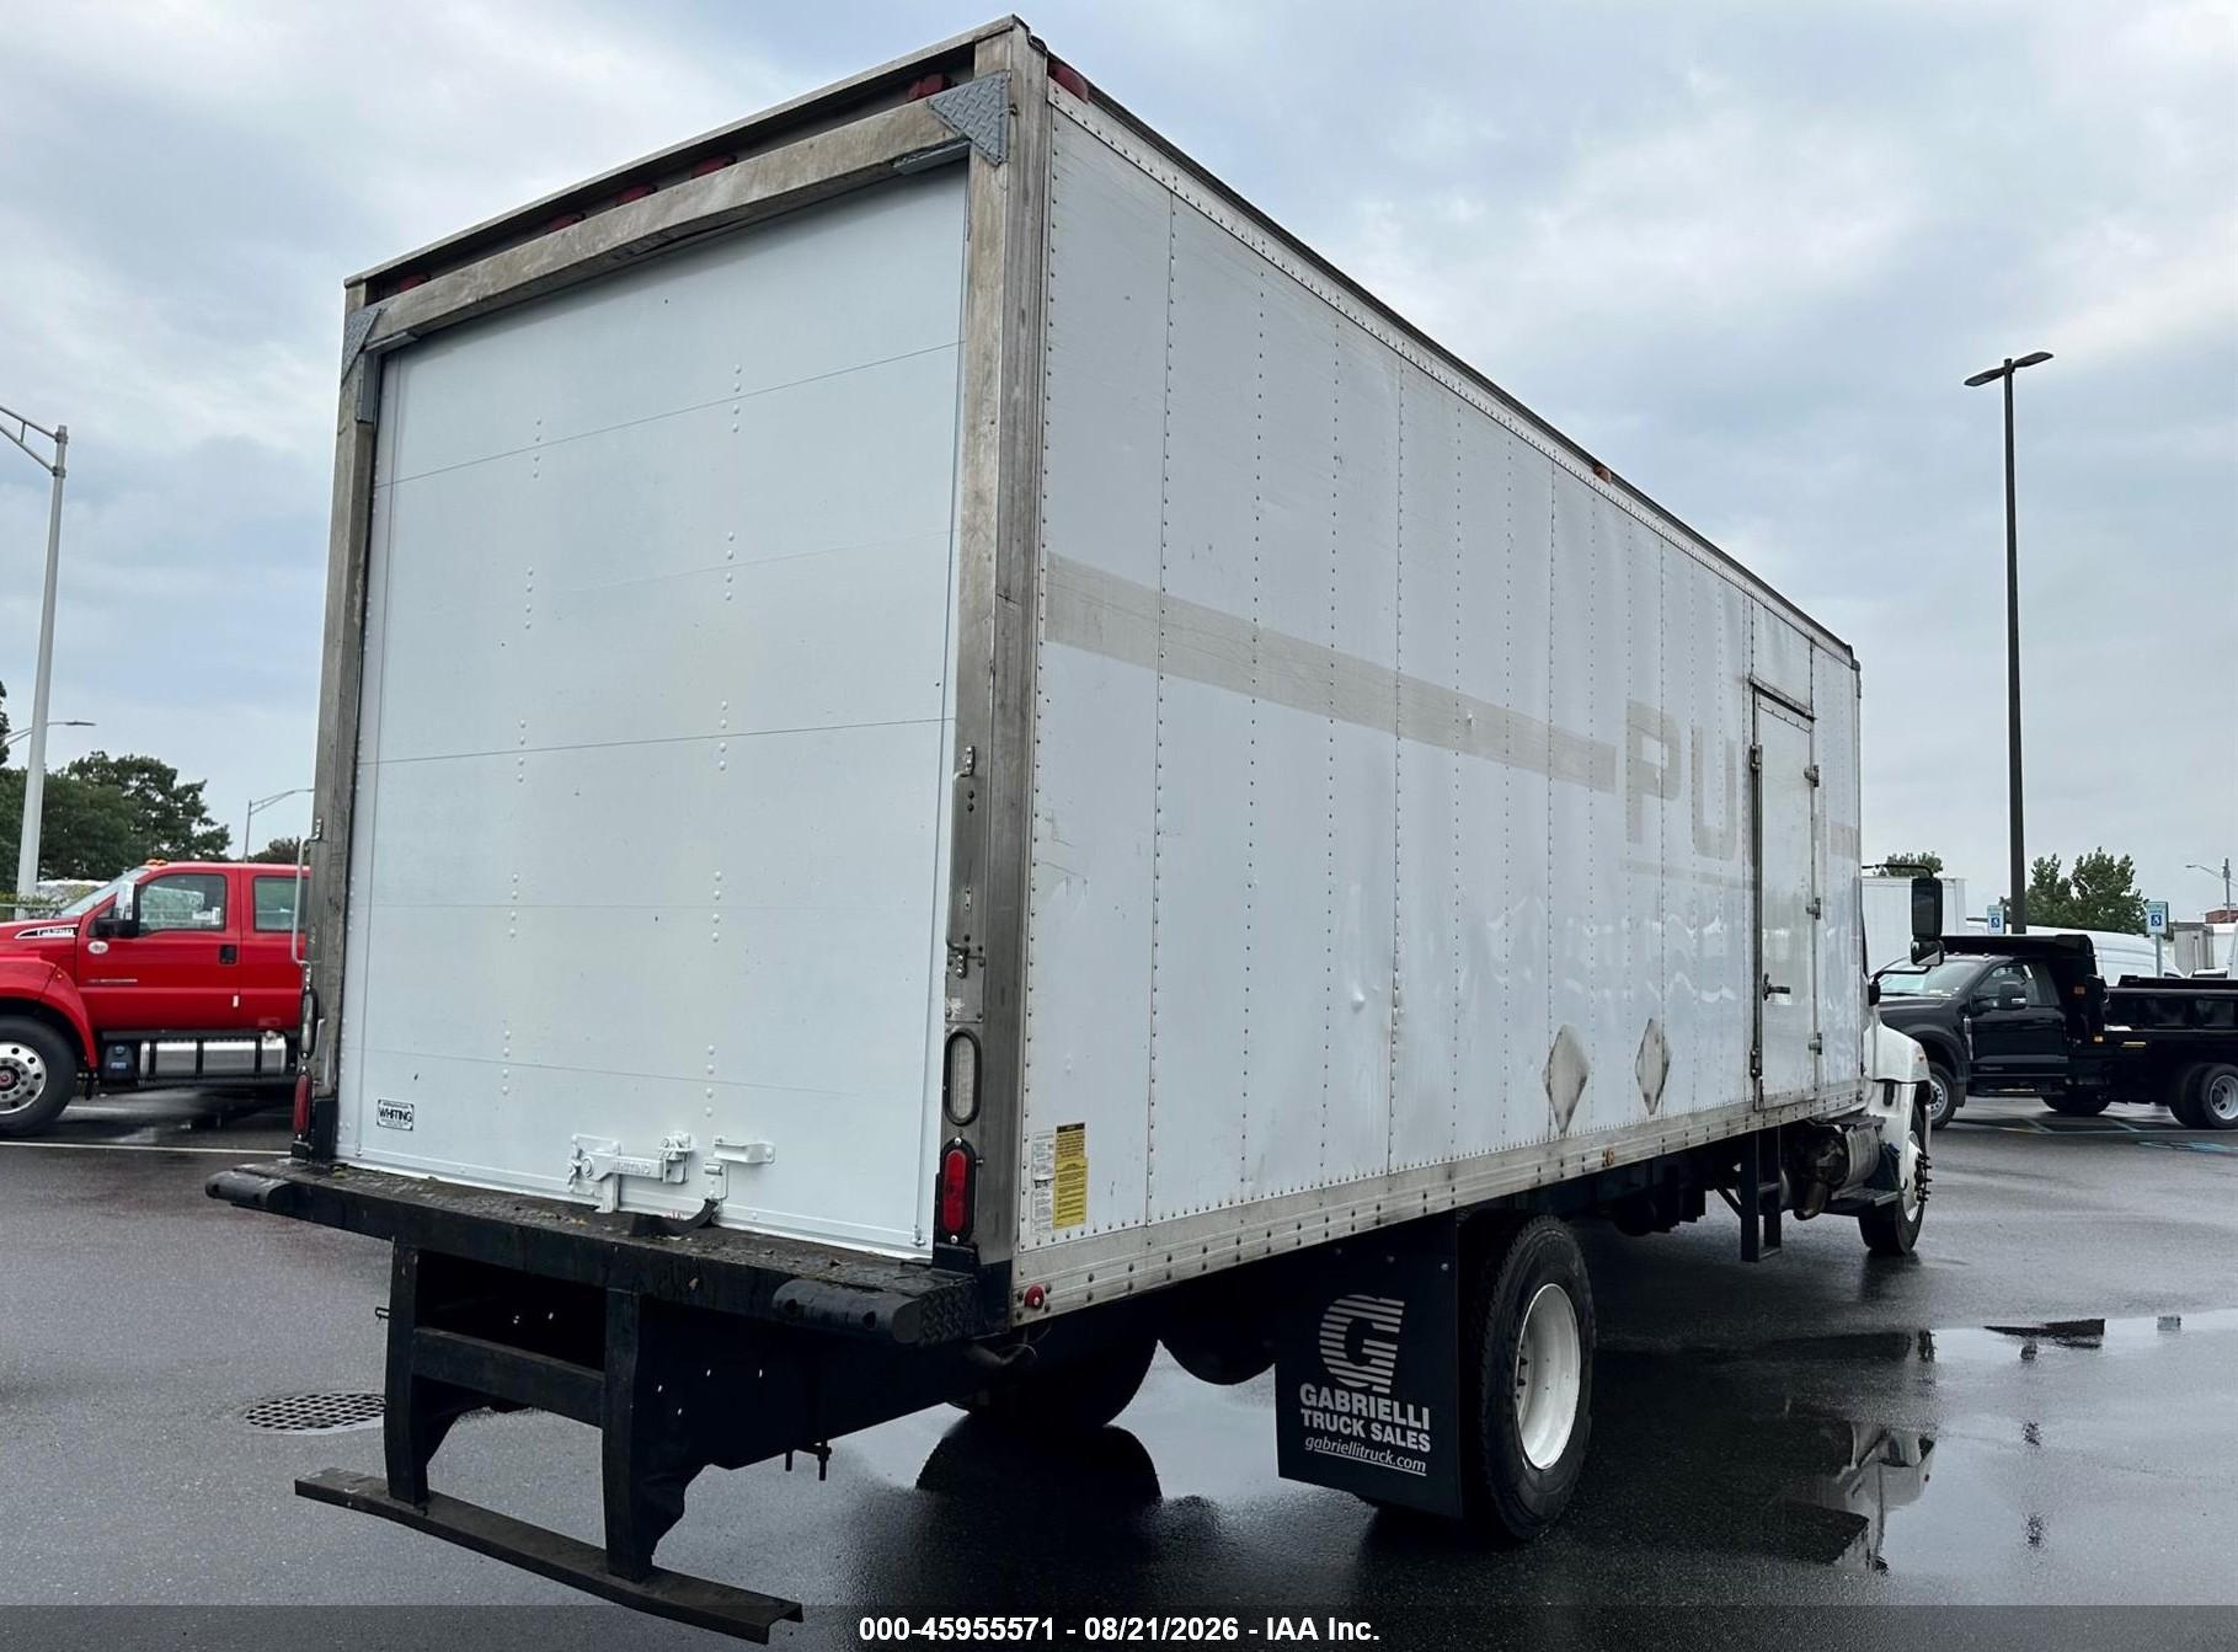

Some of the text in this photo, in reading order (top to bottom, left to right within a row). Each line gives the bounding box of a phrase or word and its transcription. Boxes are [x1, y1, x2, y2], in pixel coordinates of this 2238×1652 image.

[1299, 1383, 1430, 1431] GABRIELLI
[1300, 1408, 1432, 1453] TRUCK SALES
[1305, 1436, 1427, 1472] gabriellitruck.com
